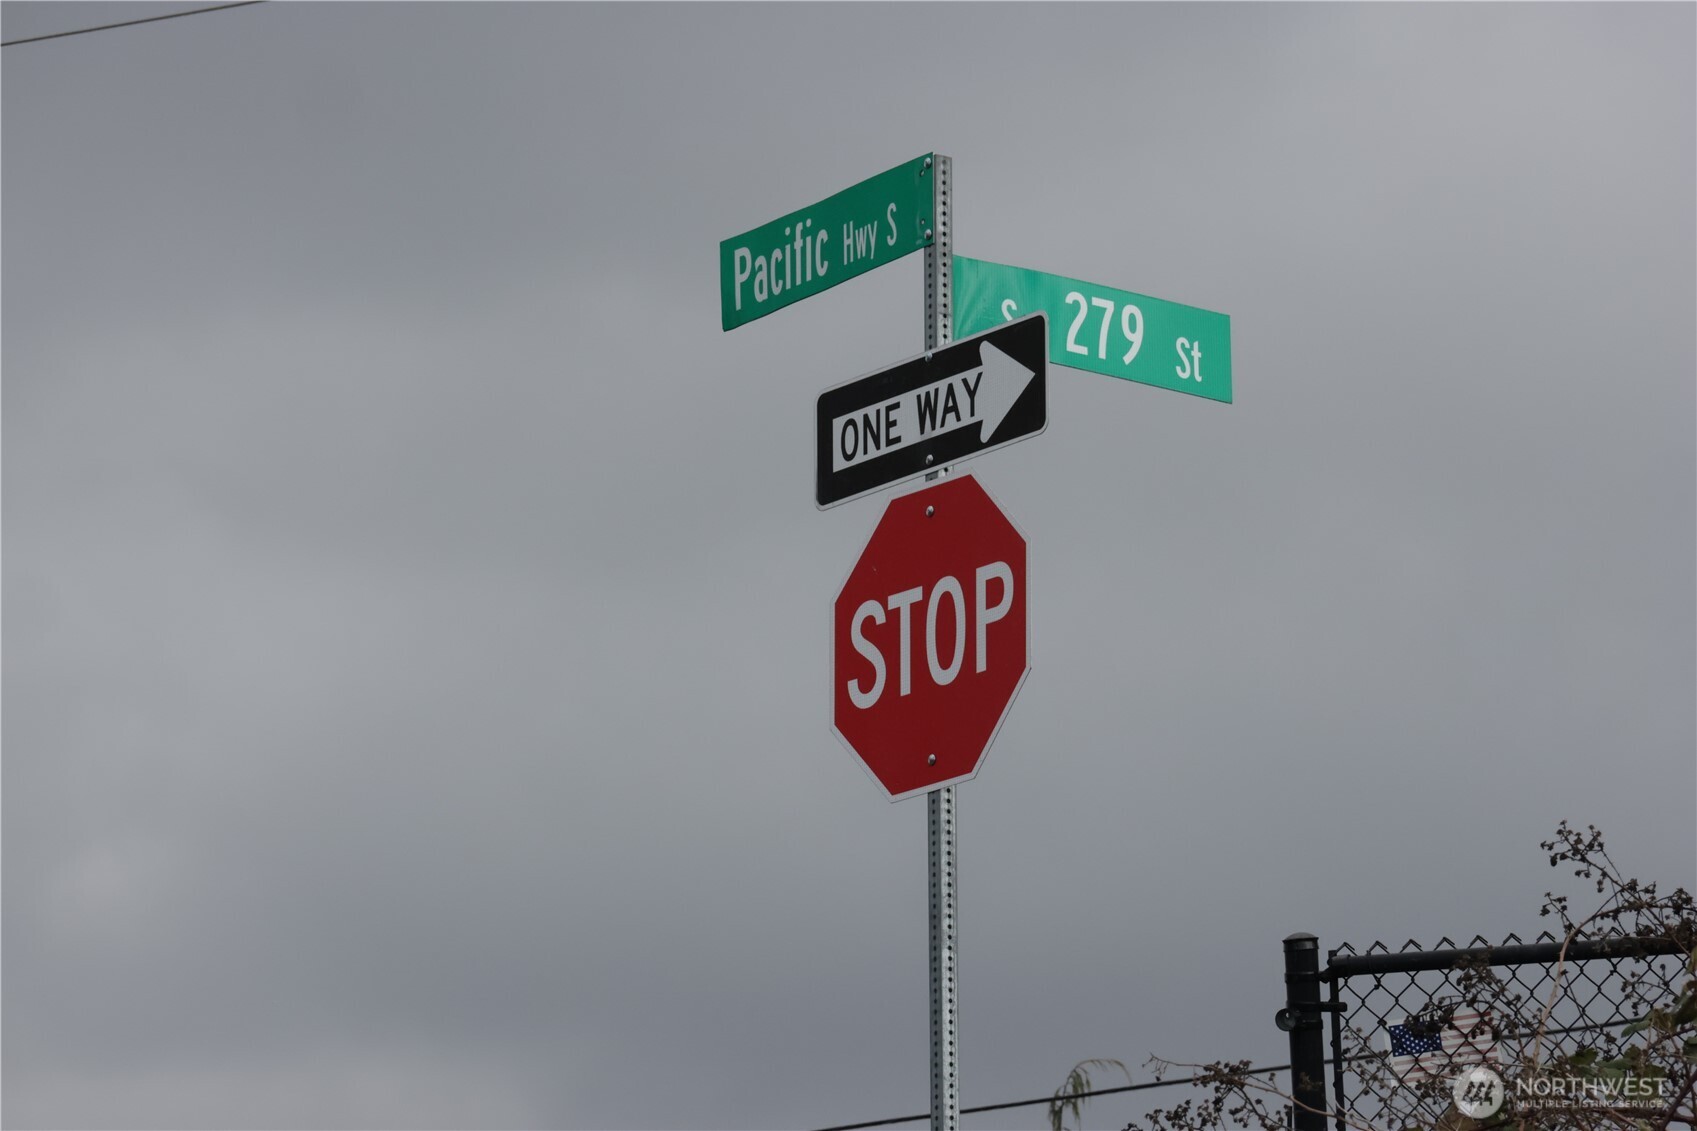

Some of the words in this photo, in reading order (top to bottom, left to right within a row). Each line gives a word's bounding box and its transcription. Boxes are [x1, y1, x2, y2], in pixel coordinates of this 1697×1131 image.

[734, 218, 829, 311] Pacific
[843, 220, 878, 265] Hwy
[886, 202, 897, 246] S
[1065, 291, 1144, 365] 279
[1176, 336, 1202, 382] St
[840, 401, 902, 462] ONE
[916, 371, 983, 436] WAY
[847, 560, 1014, 709] STOP
